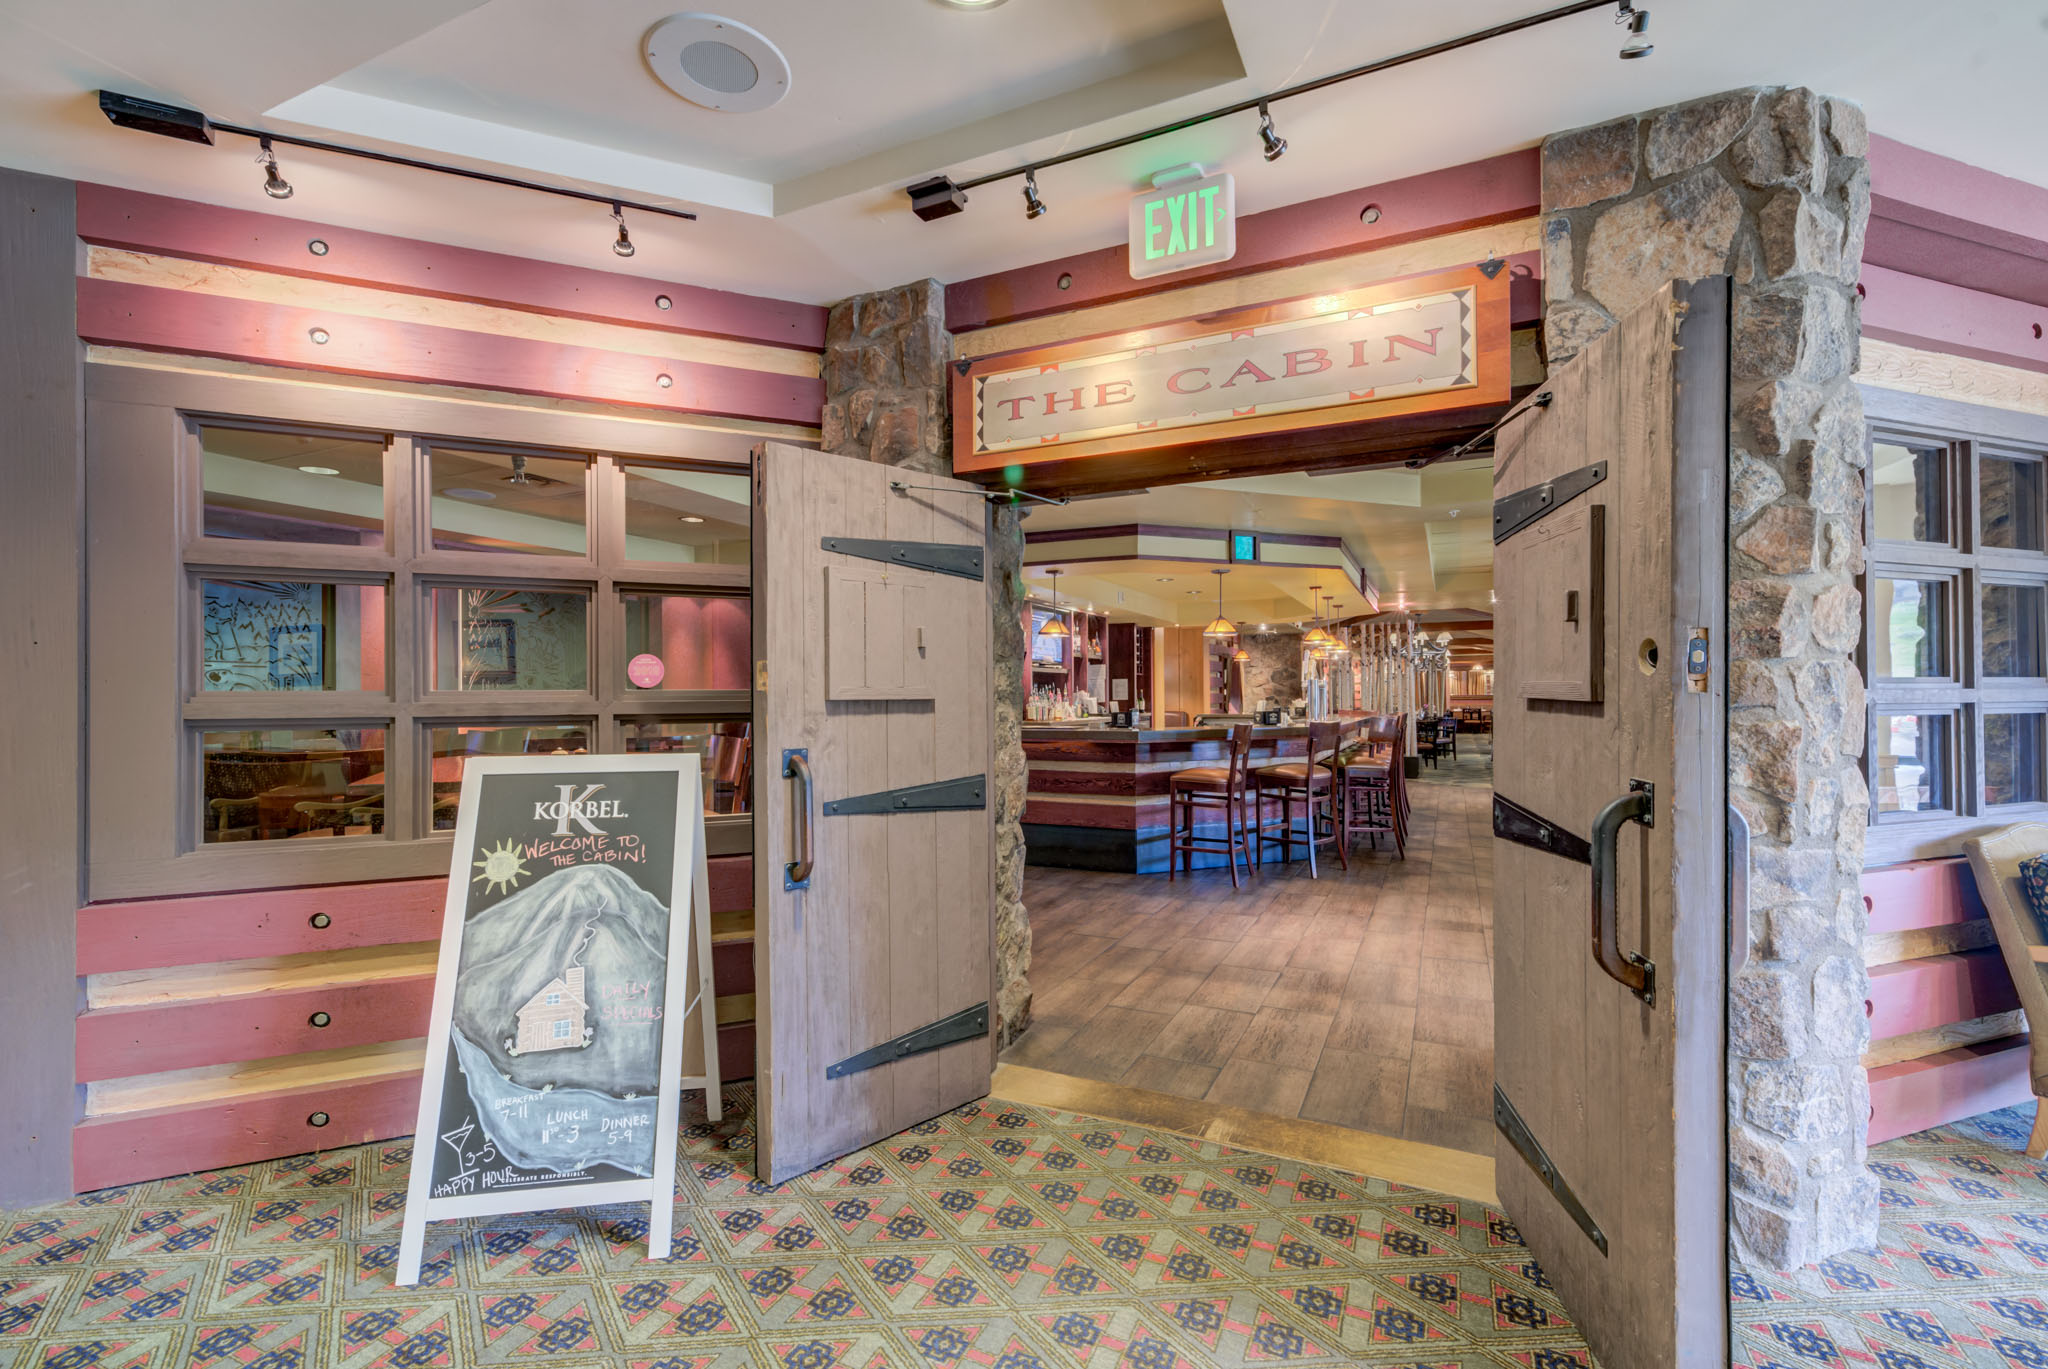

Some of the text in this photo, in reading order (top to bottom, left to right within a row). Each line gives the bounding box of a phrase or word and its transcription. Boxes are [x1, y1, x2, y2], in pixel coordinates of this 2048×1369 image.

[1145, 185, 1219, 260] EXIT
[997, 327, 1443, 421] THE CABIN
[525, 835, 640, 859] WELCOME TO
[550, 844, 647, 866] THE CABIN!
[602, 980, 650, 1000] DAILY
[600, 1006, 663, 1020] SPECIALS
[495, 1092, 544, 1109] BREAKFAST
[500, 1104, 528, 1122] 7-11
[547, 1109, 588, 1125] LUNCH
[601, 1114, 649, 1132] DINNER
[608, 1129, 632, 1145] 5-9
[465, 1142, 496, 1166] 3-5
[434, 1165, 519, 1198] HAPPY HOUR
